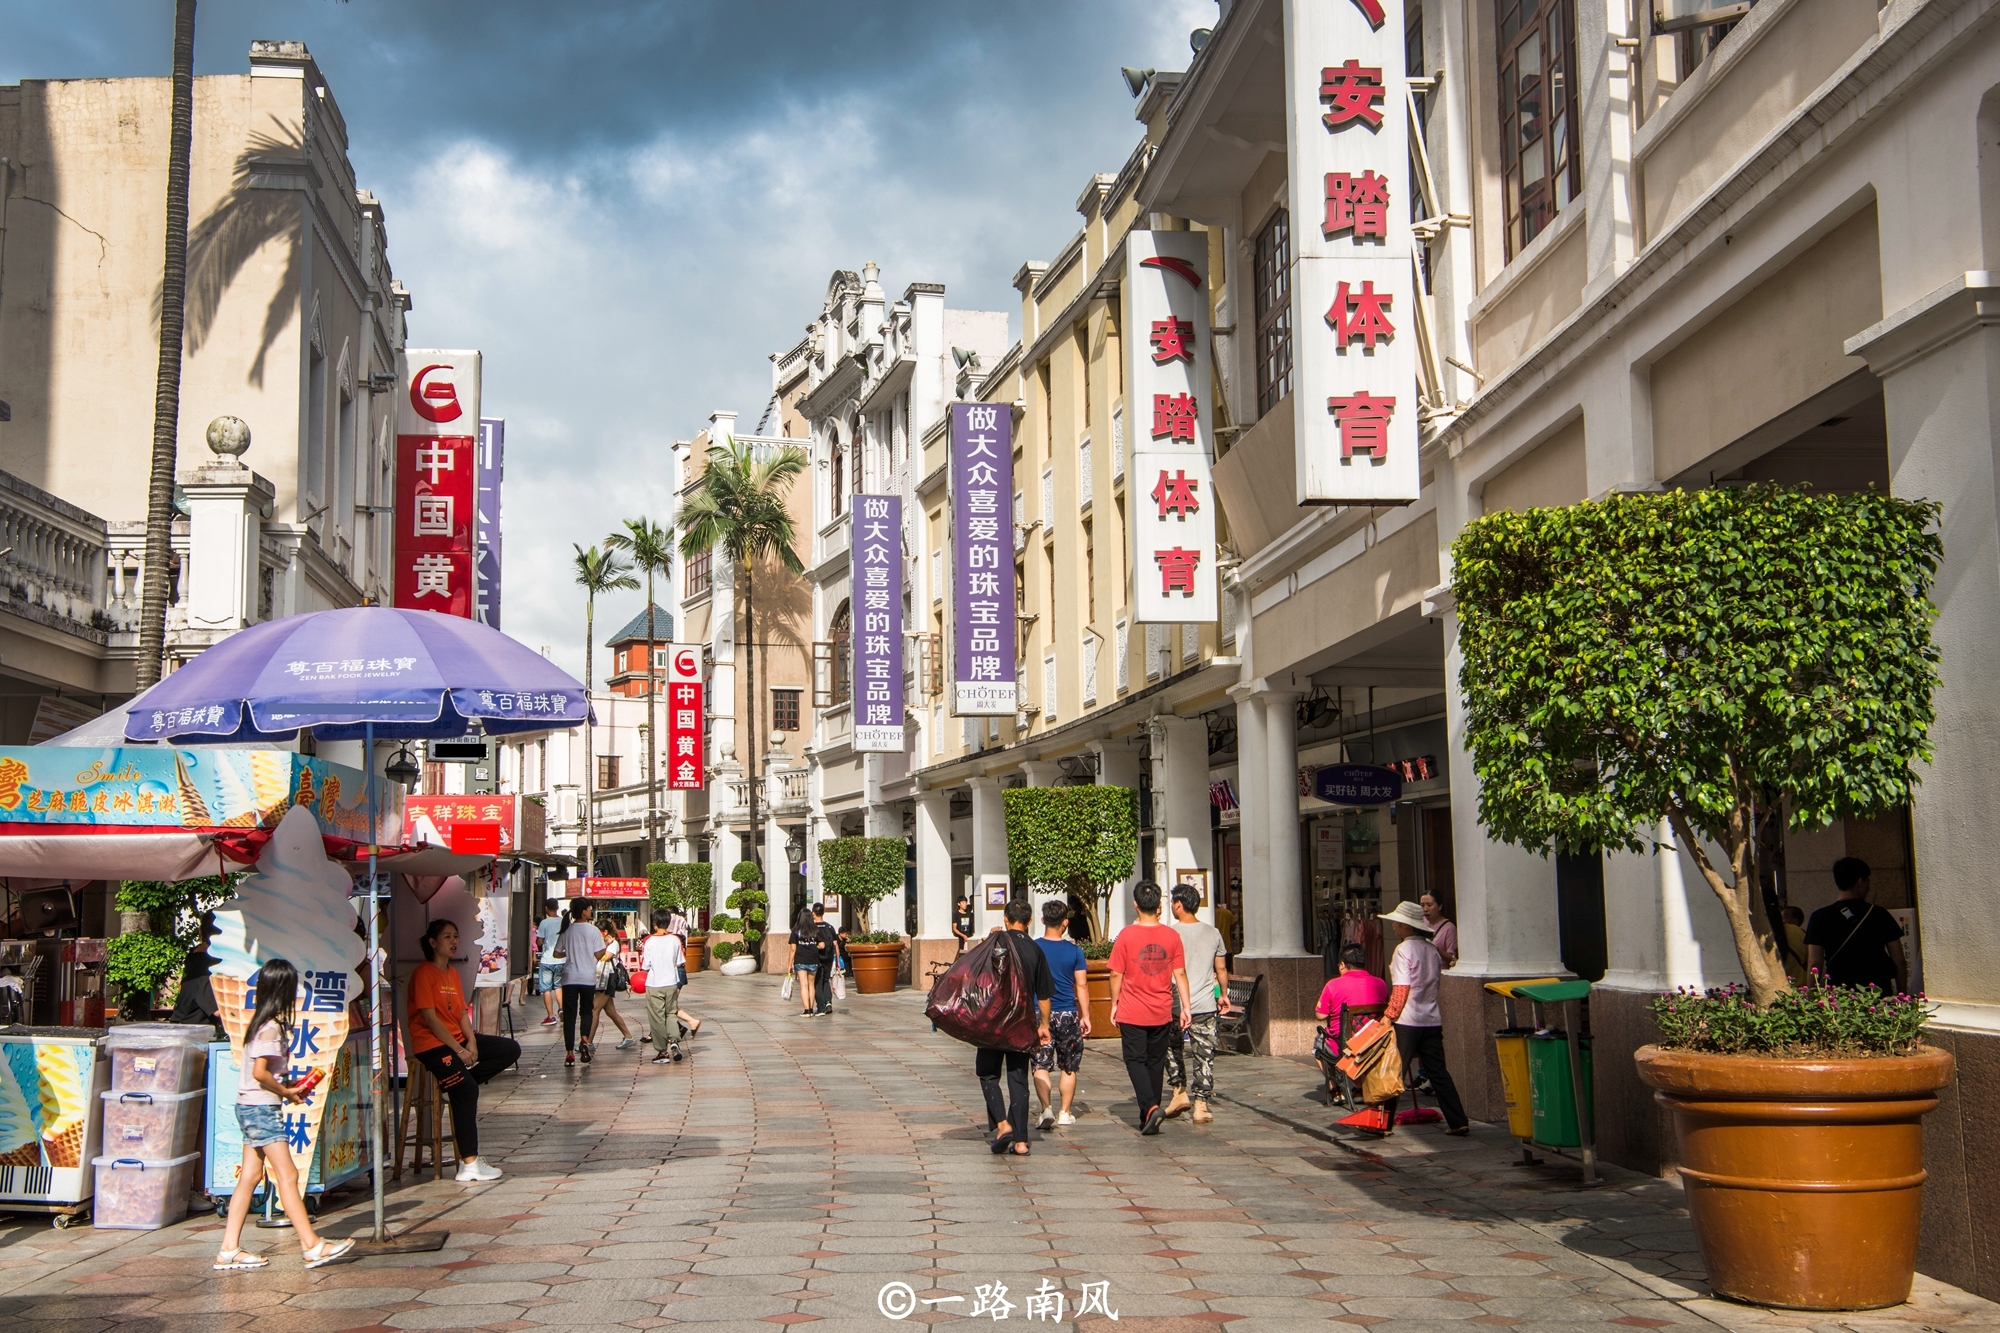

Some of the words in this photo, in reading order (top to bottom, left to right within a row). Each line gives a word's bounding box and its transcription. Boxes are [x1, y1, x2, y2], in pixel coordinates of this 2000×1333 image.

[1319, 59, 1397, 464] 安踏体育
[1149, 315, 1201, 595] 安踏体育
[412, 441, 455, 612] 中国黄
[966, 406, 1002, 681] 做大众喜爱的珠宝品牌
[863, 498, 893, 726] 做大众喜爱的珠宝品牌
[76, 761, 141, 785] Smile
[676, 684, 696, 781] 中国黄金
[1325, 784, 1357, 796] 买好钻
[1360, 785, 1393, 798] 周大发
[27, 789, 179, 813] 芝麻脆皮冰淇淋
[330, 1101, 349, 1134] 手工
